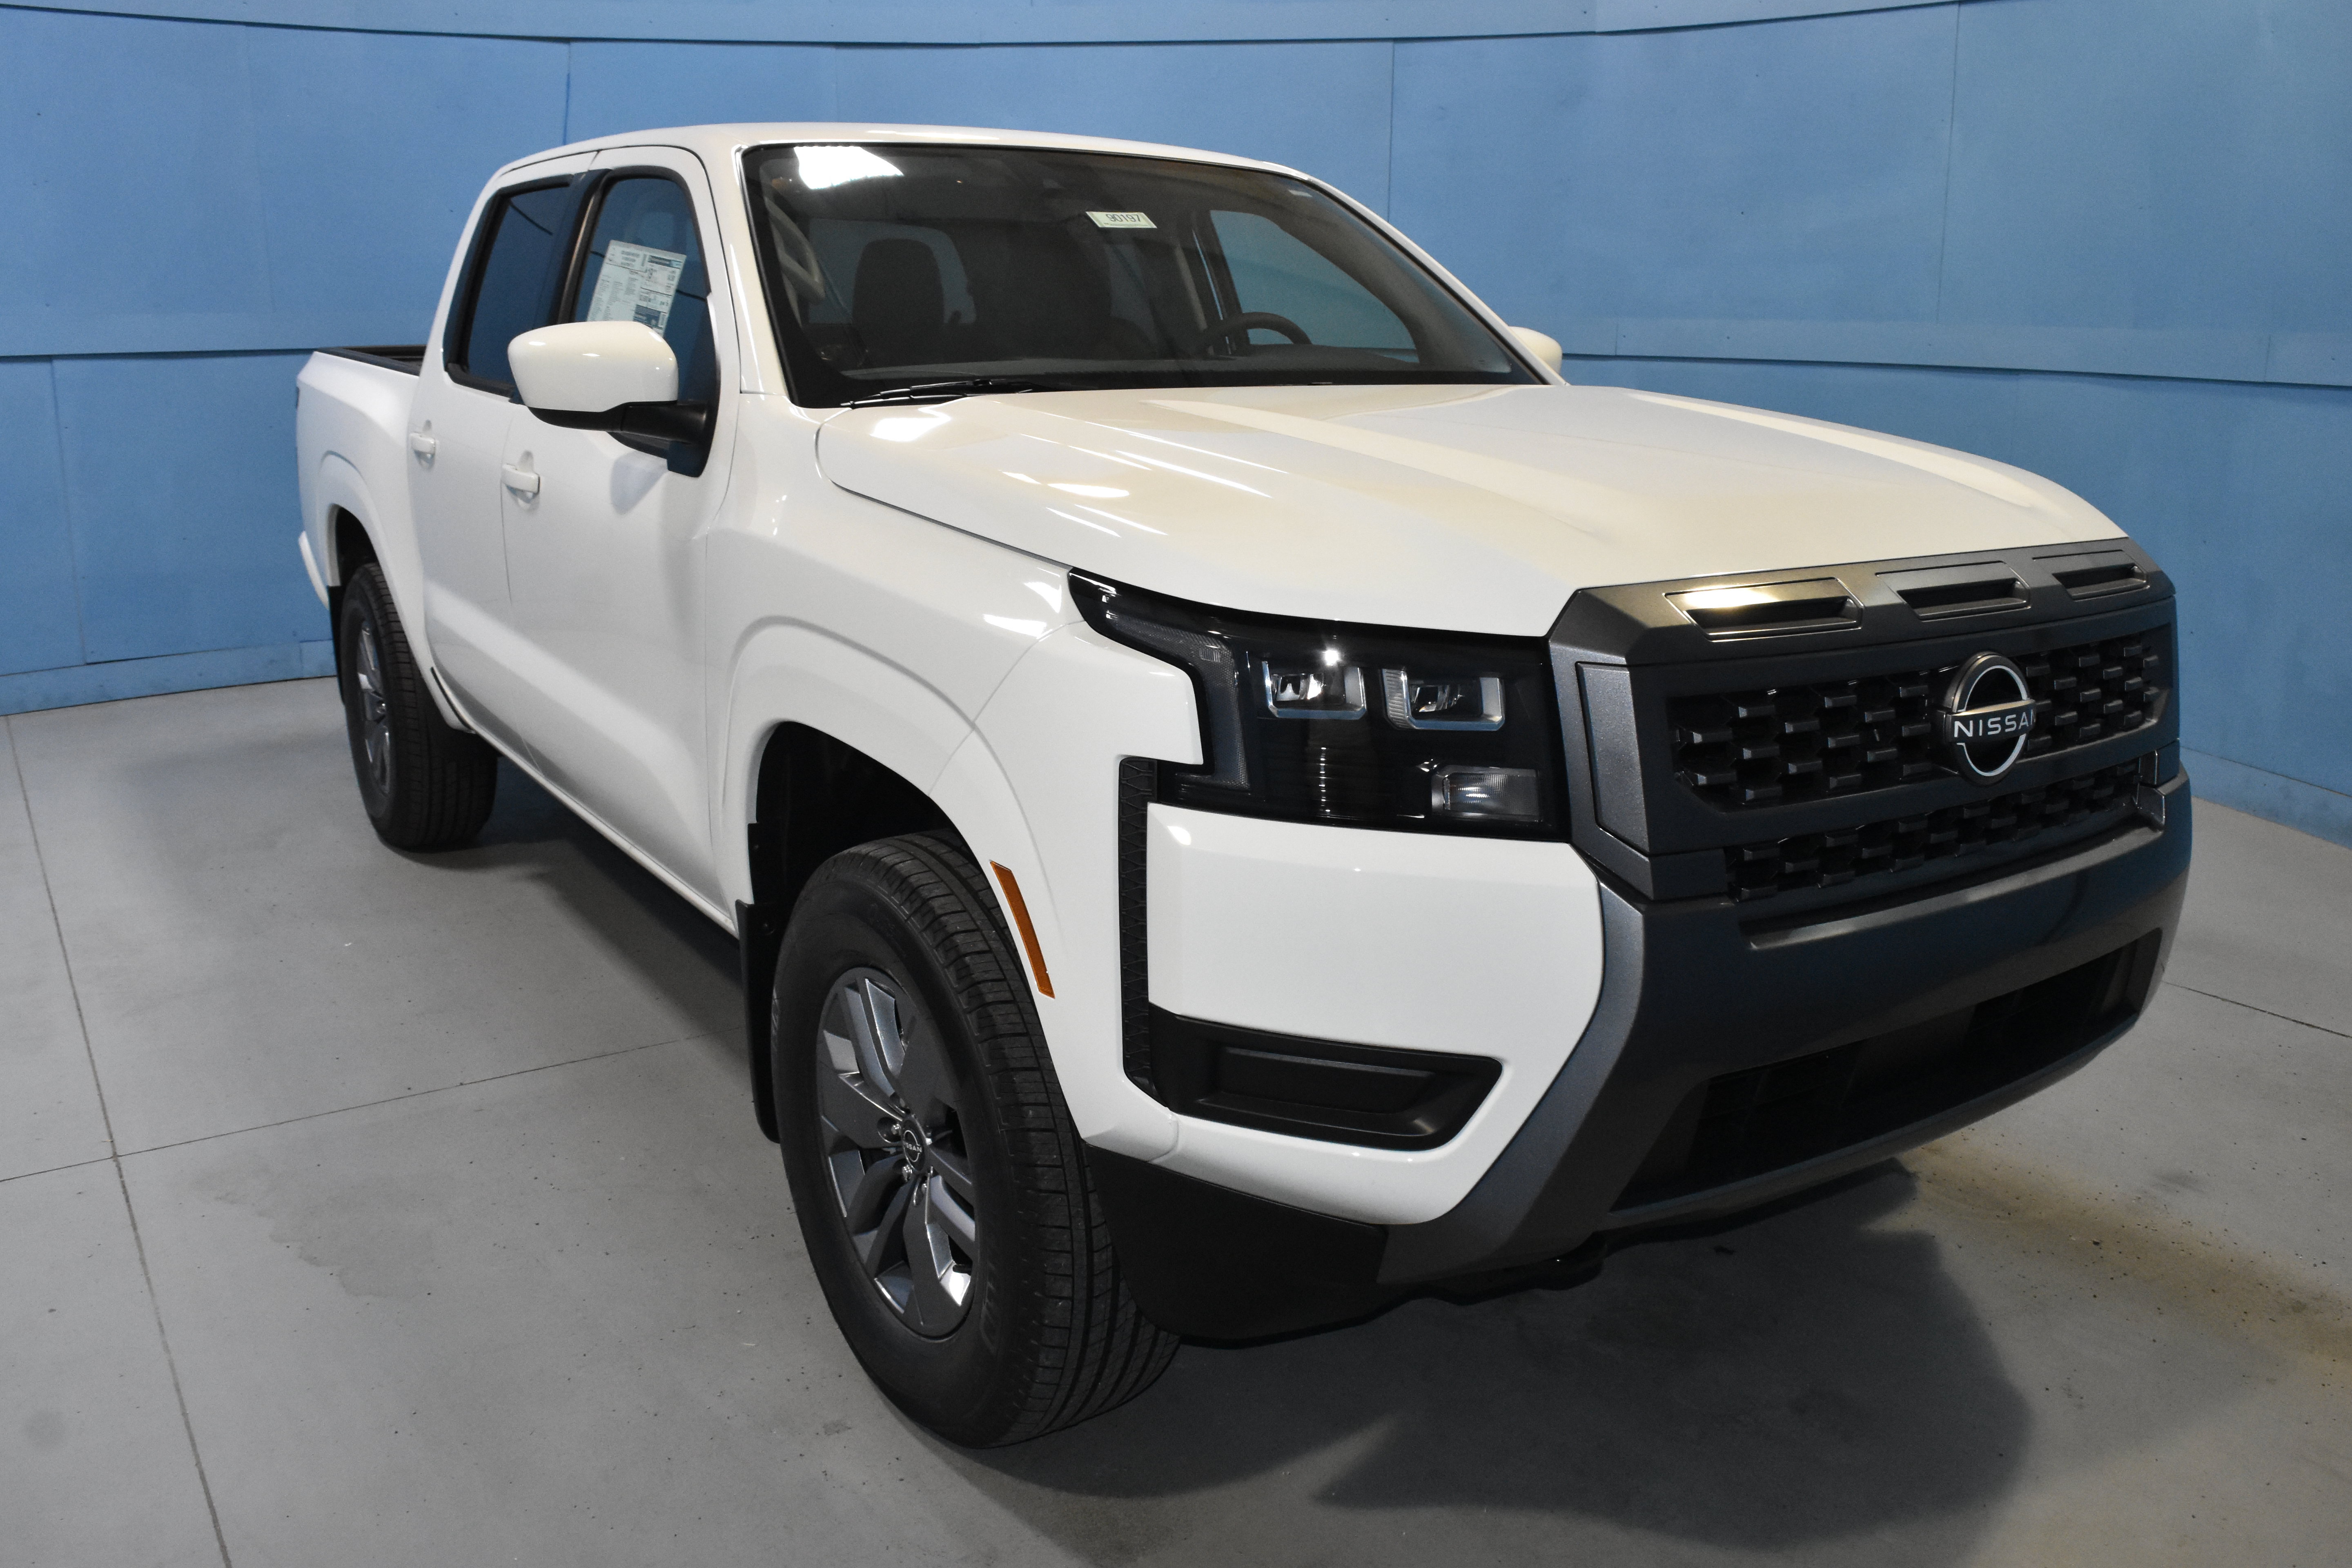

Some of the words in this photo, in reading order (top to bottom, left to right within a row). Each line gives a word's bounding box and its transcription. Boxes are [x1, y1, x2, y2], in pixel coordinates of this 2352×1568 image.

[1105, 214, 1141, 223] 90197
[1954, 709, 2036, 738] NISSAN
[905, 1142, 922, 1152] SSAN
